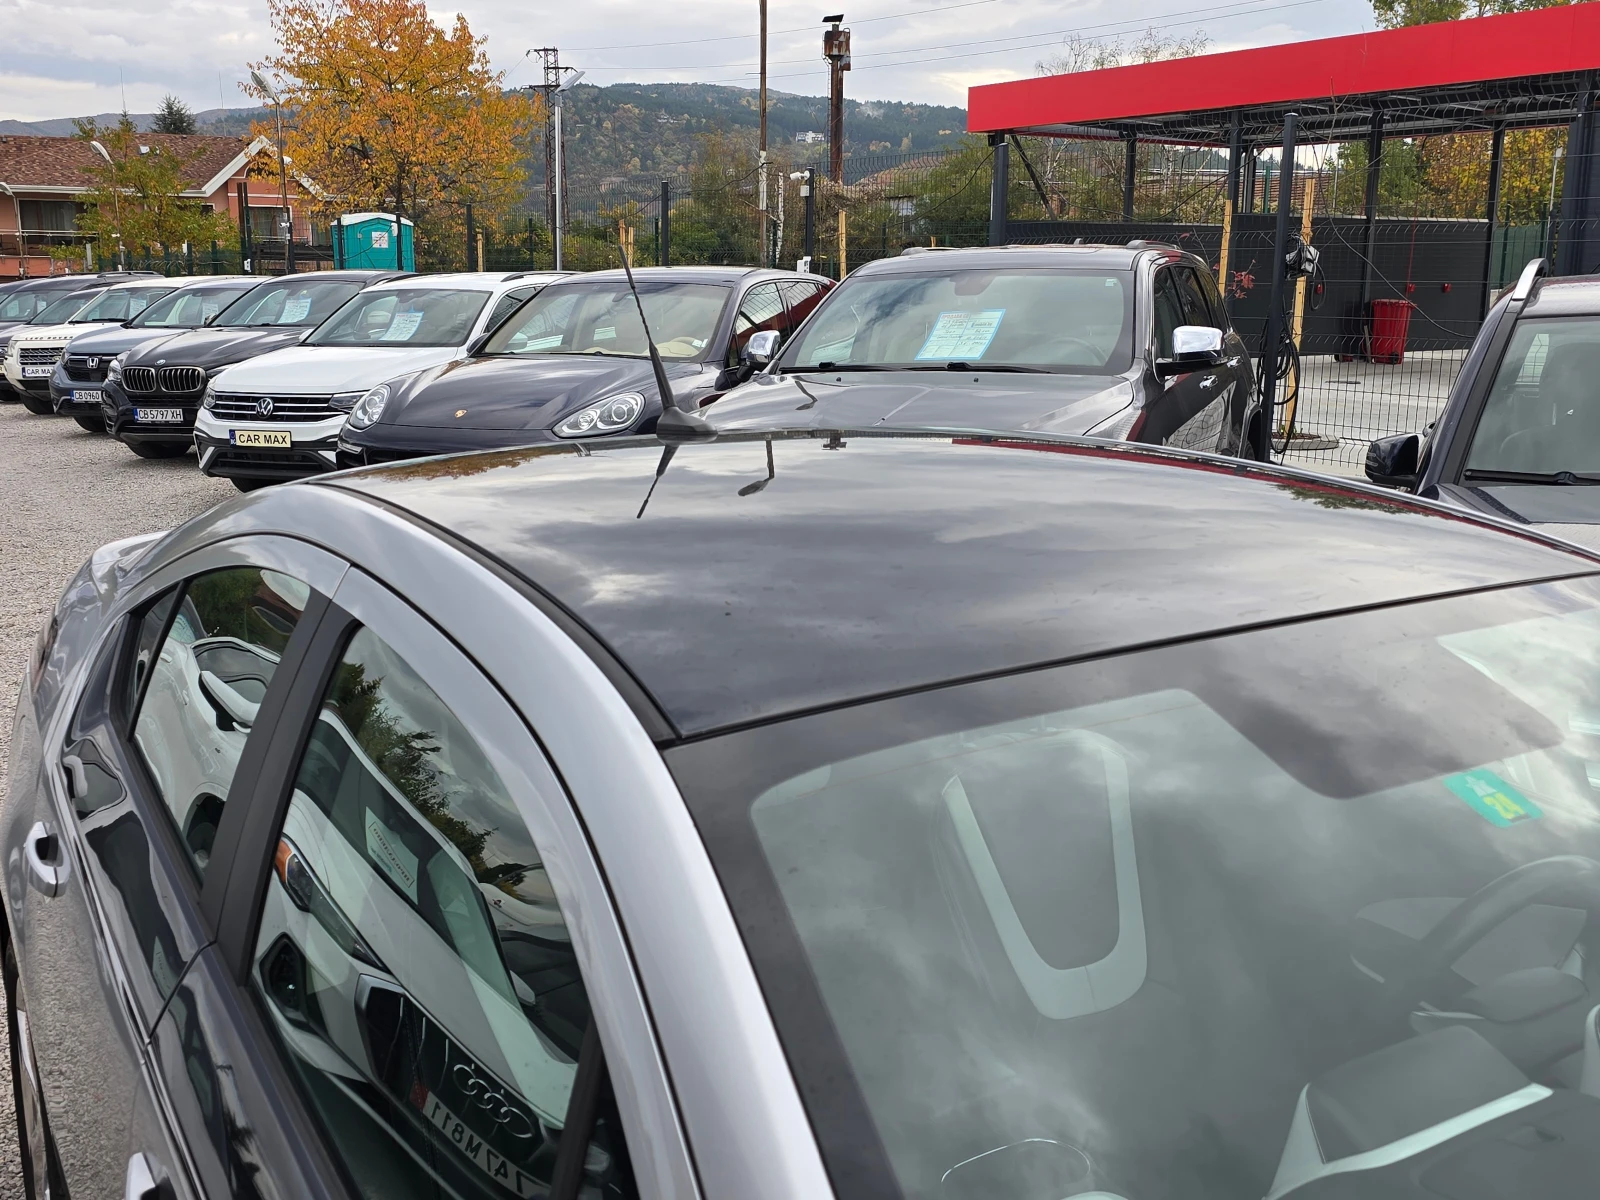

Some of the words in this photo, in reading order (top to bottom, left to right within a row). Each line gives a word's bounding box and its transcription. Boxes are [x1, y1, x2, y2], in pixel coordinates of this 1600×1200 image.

[75, 391, 83, 400] CB
[84, 391, 100, 400] 0960
[139, 410, 149, 420] CB
[150, 410, 169, 420] 5797
[238, 434, 261, 444] CAR
[263, 434, 288, 445] MAX
